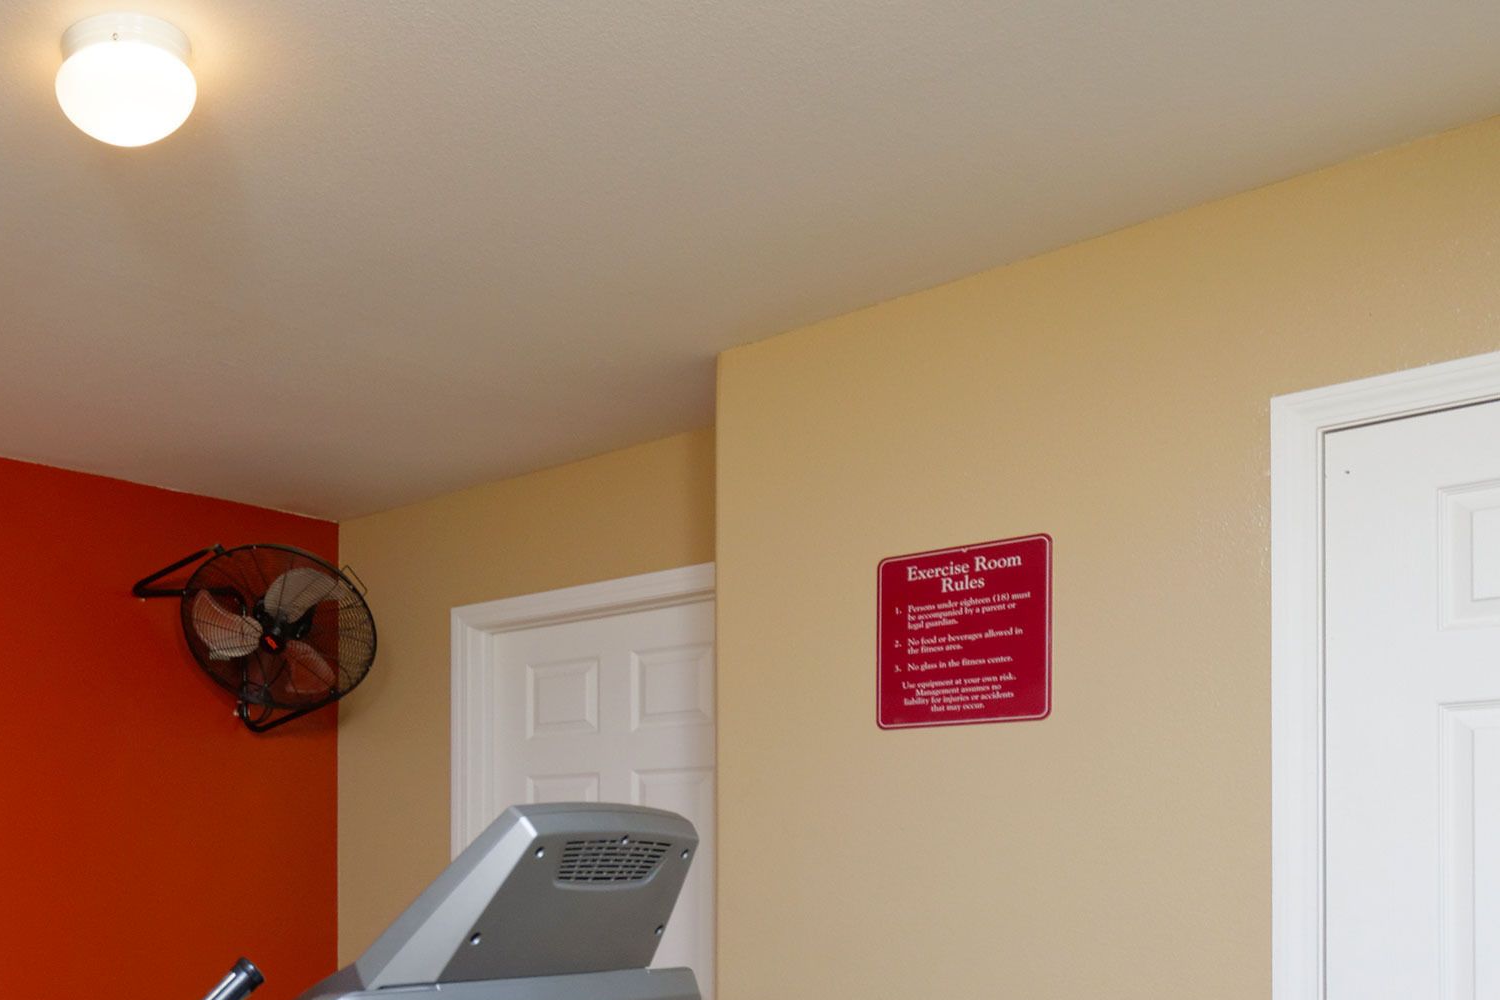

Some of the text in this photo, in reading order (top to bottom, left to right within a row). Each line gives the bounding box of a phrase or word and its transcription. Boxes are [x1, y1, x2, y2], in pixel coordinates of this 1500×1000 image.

[906, 555, 1022, 581] Exercise Room
[941, 575, 985, 593] Rules
[908, 604, 935, 613] Persons
[937, 600, 958, 610] under
[960, 598, 991, 609] eighteen
[993, 592, 1009, 603] (18)
[1012, 592, 1031, 600] must
[918, 607, 963, 619] accompanied
[965, 606, 973, 615] by
[982, 603, 1005, 614] parent
[908, 618, 958, 630] legal guardian.
[908, 638, 919, 646] No
[921, 636, 936, 645] food
[984, 628, 1013, 638] allowed
[1015, 627, 1023, 635] in
[908, 646, 919, 655] the
[921, 644, 944, 653] fitness
[908, 663, 919, 671] No
[921, 662, 937, 672] glass
[939, 660, 946, 668] in
[948, 659, 960, 667] the
[962, 658, 986, 666] fitness
[988, 656, 1012, 664] center.
[902, 681, 915, 689] Use
[917, 679, 953, 689] equipment
[916, 688, 959, 698] Management
[961, 685, 990, 693] assumes
[904, 698, 928, 706] liability
[943, 694, 969, 703] injuries
[981, 692, 1014, 700] accidents
[931, 704, 944, 712] that
